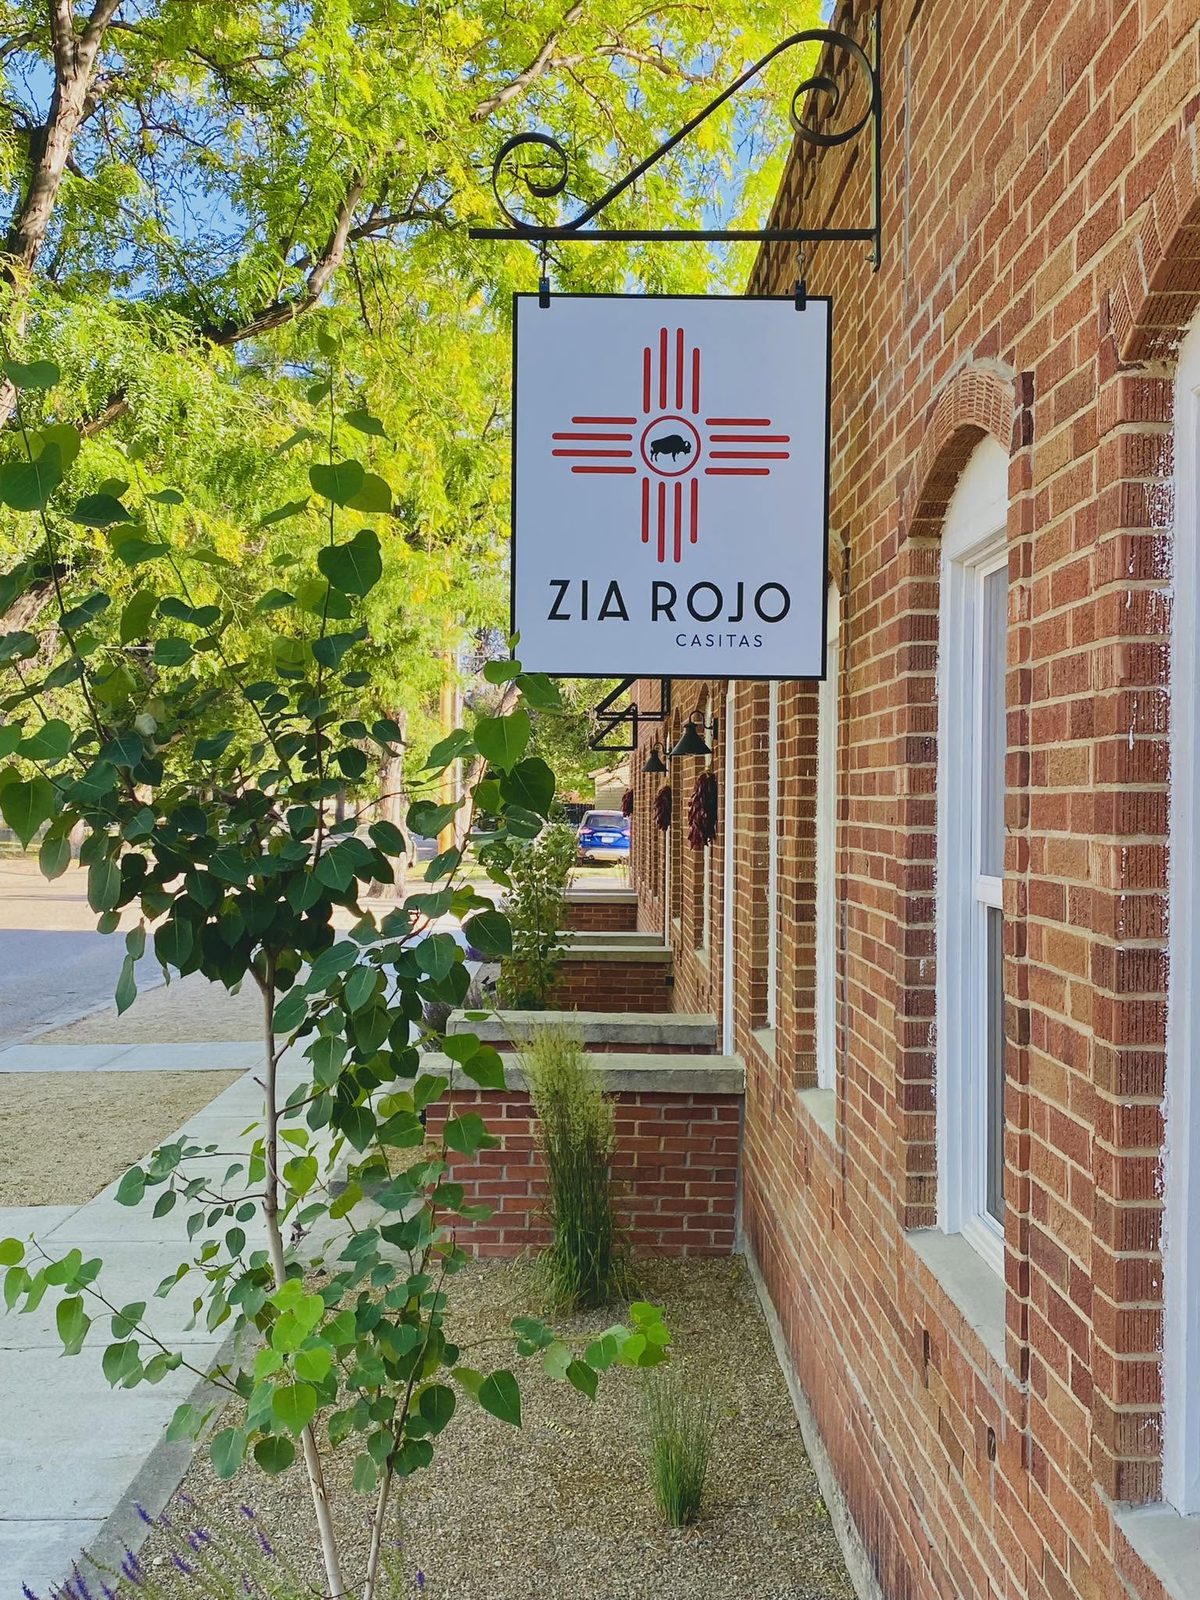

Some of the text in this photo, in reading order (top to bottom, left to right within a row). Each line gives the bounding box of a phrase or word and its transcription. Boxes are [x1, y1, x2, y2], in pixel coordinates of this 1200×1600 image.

[547, 579, 791, 623] ZIA ROJO
[675, 633, 763, 648] CASITAS
